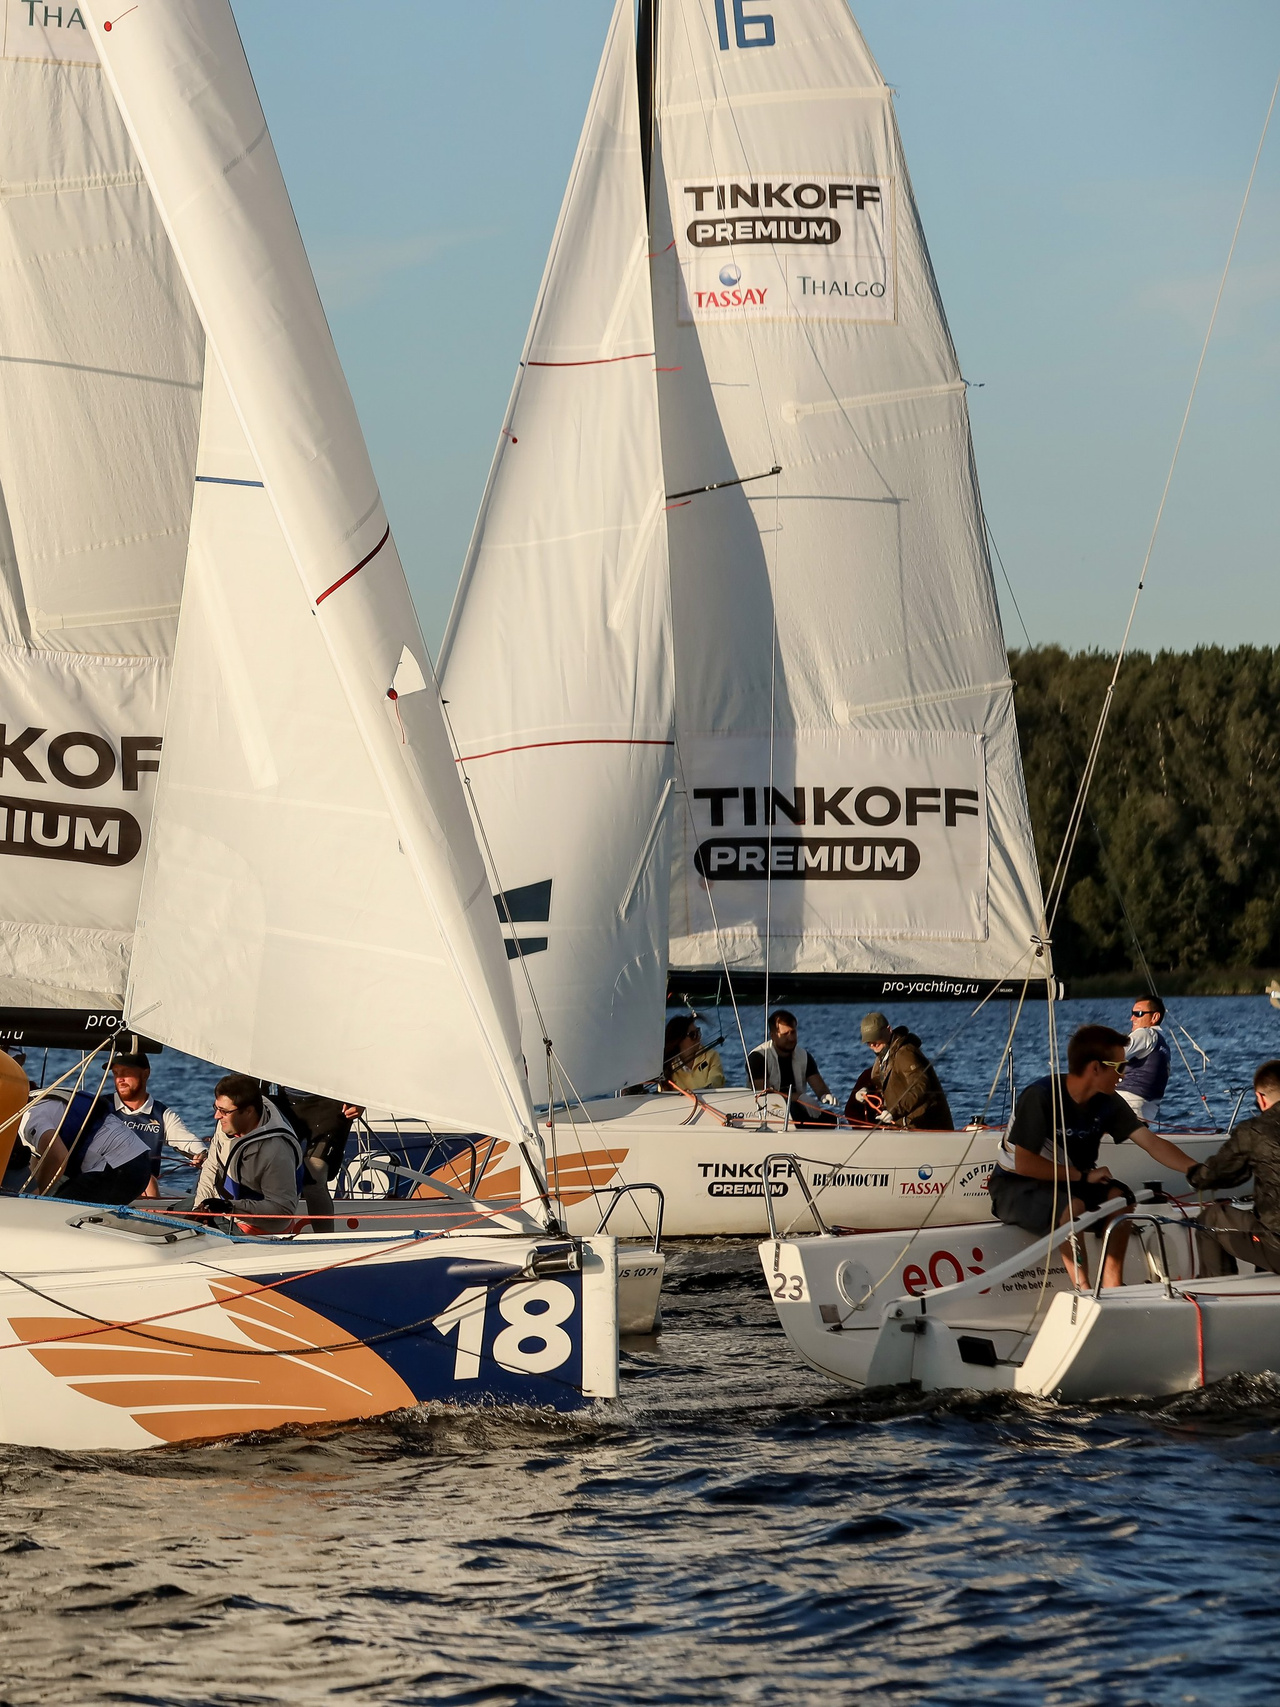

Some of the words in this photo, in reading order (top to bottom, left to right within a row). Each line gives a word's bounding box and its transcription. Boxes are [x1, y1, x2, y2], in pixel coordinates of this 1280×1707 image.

[715, 0, 775, 50] 16
[684, 183, 880, 211] TINKOFF
[696, 221, 831, 243] PREMIUM
[694, 288, 768, 308] TASSAY
[796, 276, 886, 298] THALGO
[693, 786, 979, 827] TINKOFF
[710, 846, 906, 872] PREMIUM
[882, 981, 979, 995] pro-yachting.ru
[698, 1163, 802, 1178] TINKOFF
[900, 1183, 948, 1194] TASSAY
[634, 1267, 658, 1277] 1071
[773, 1273, 803, 1300] 23
[1002, 1283, 1014, 1292] for
[1015, 1282, 1028, 1291] the
[432, 1279, 576, 1380] 18
